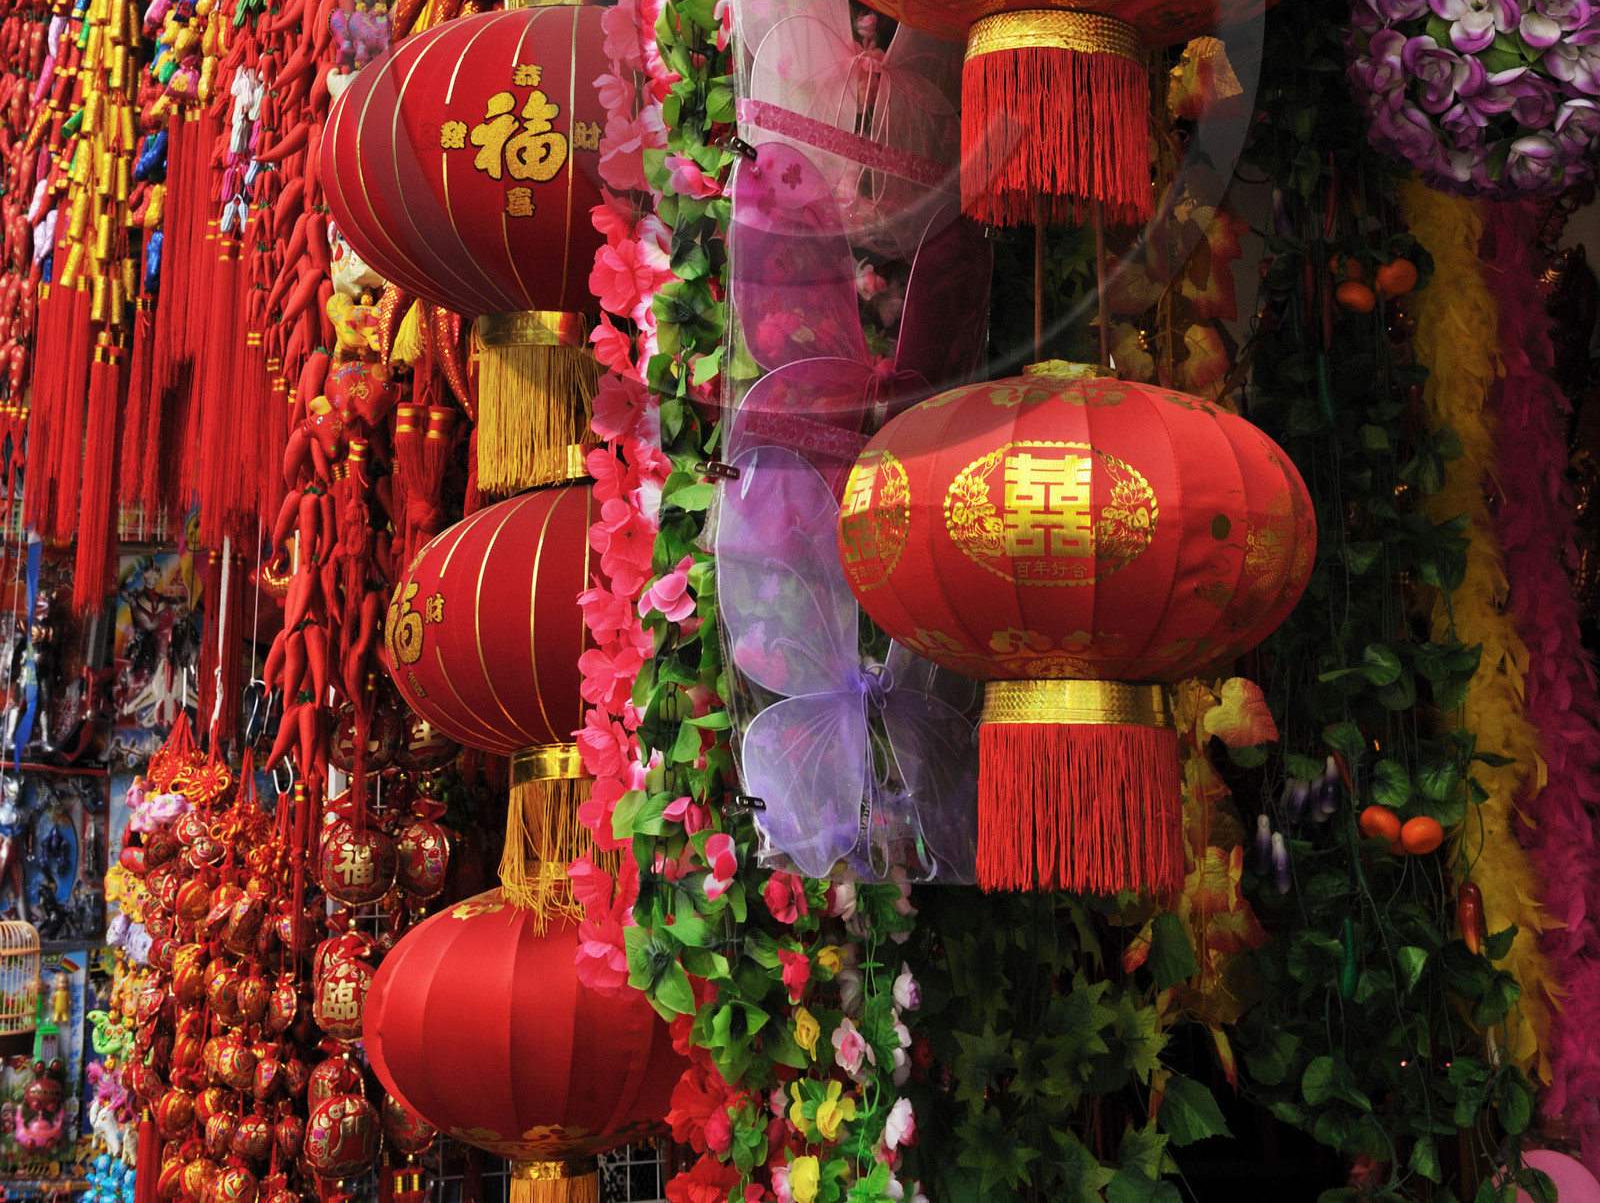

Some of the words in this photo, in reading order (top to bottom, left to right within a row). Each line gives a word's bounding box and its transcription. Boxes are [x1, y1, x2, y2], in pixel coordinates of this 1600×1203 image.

[470, 90, 569, 183] 福
[1015, 559, 1088, 580] 百年好合
[385, 580, 424, 671] 福
[425, 592, 445, 625] 財
[334, 843, 375, 886] 福
[322, 979, 359, 1021] 臨
